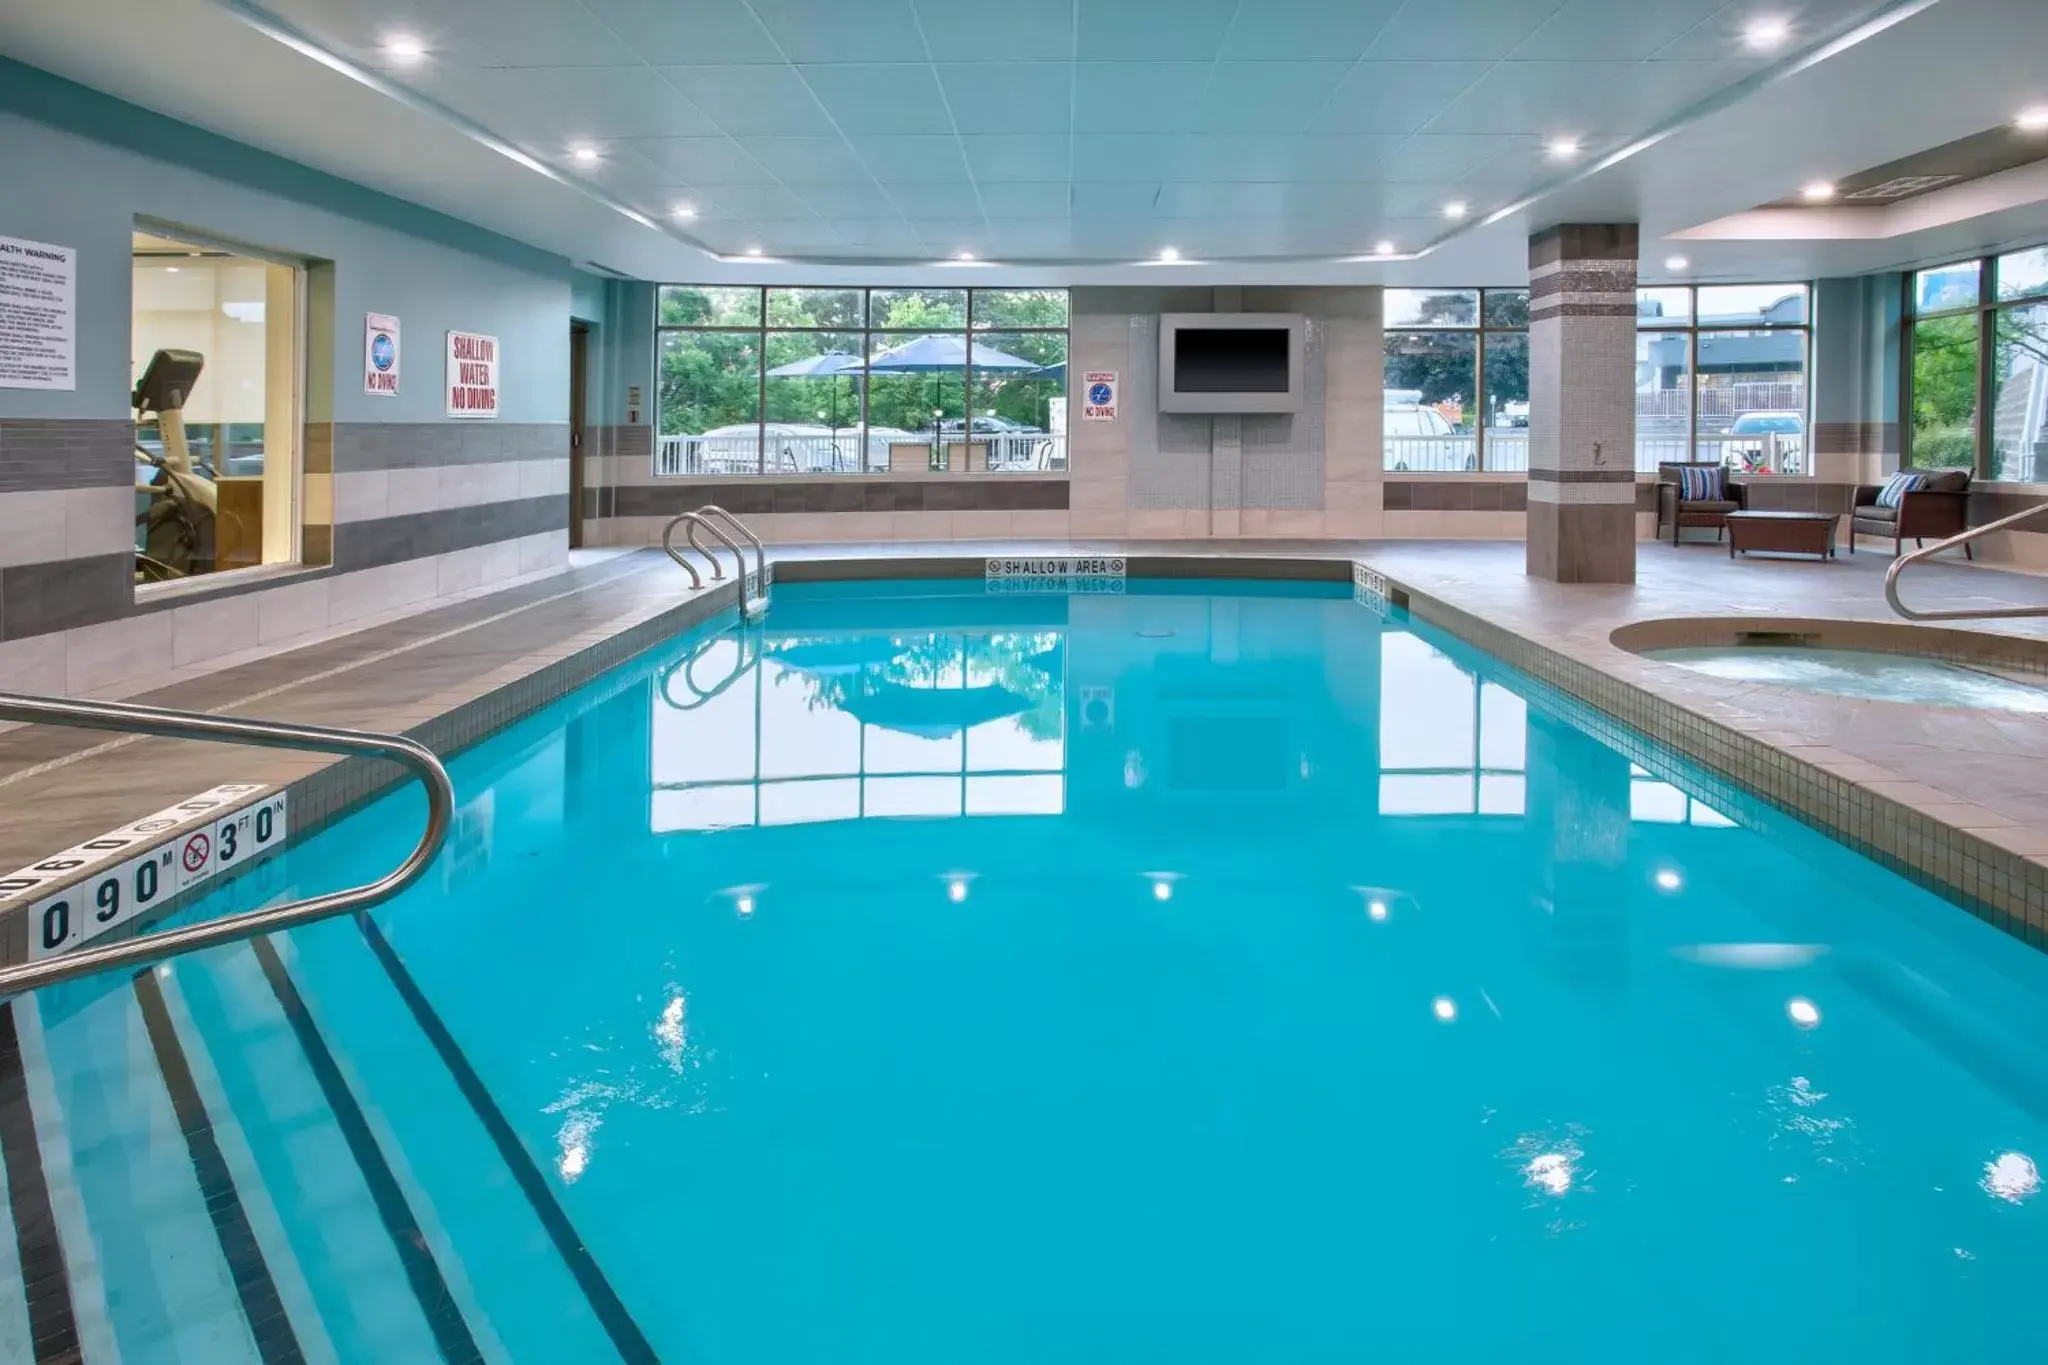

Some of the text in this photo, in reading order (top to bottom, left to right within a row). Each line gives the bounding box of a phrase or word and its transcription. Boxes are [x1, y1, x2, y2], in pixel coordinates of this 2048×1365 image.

[24, 248, 66, 263] WARNING
[454, 336, 494, 362] SHALLOW
[367, 371, 397, 391] NO DIVING
[459, 362, 490, 386] WATER
[452, 386, 495, 410] NO DIVING
[1004, 560, 1107, 574] SHALLOW AREA
